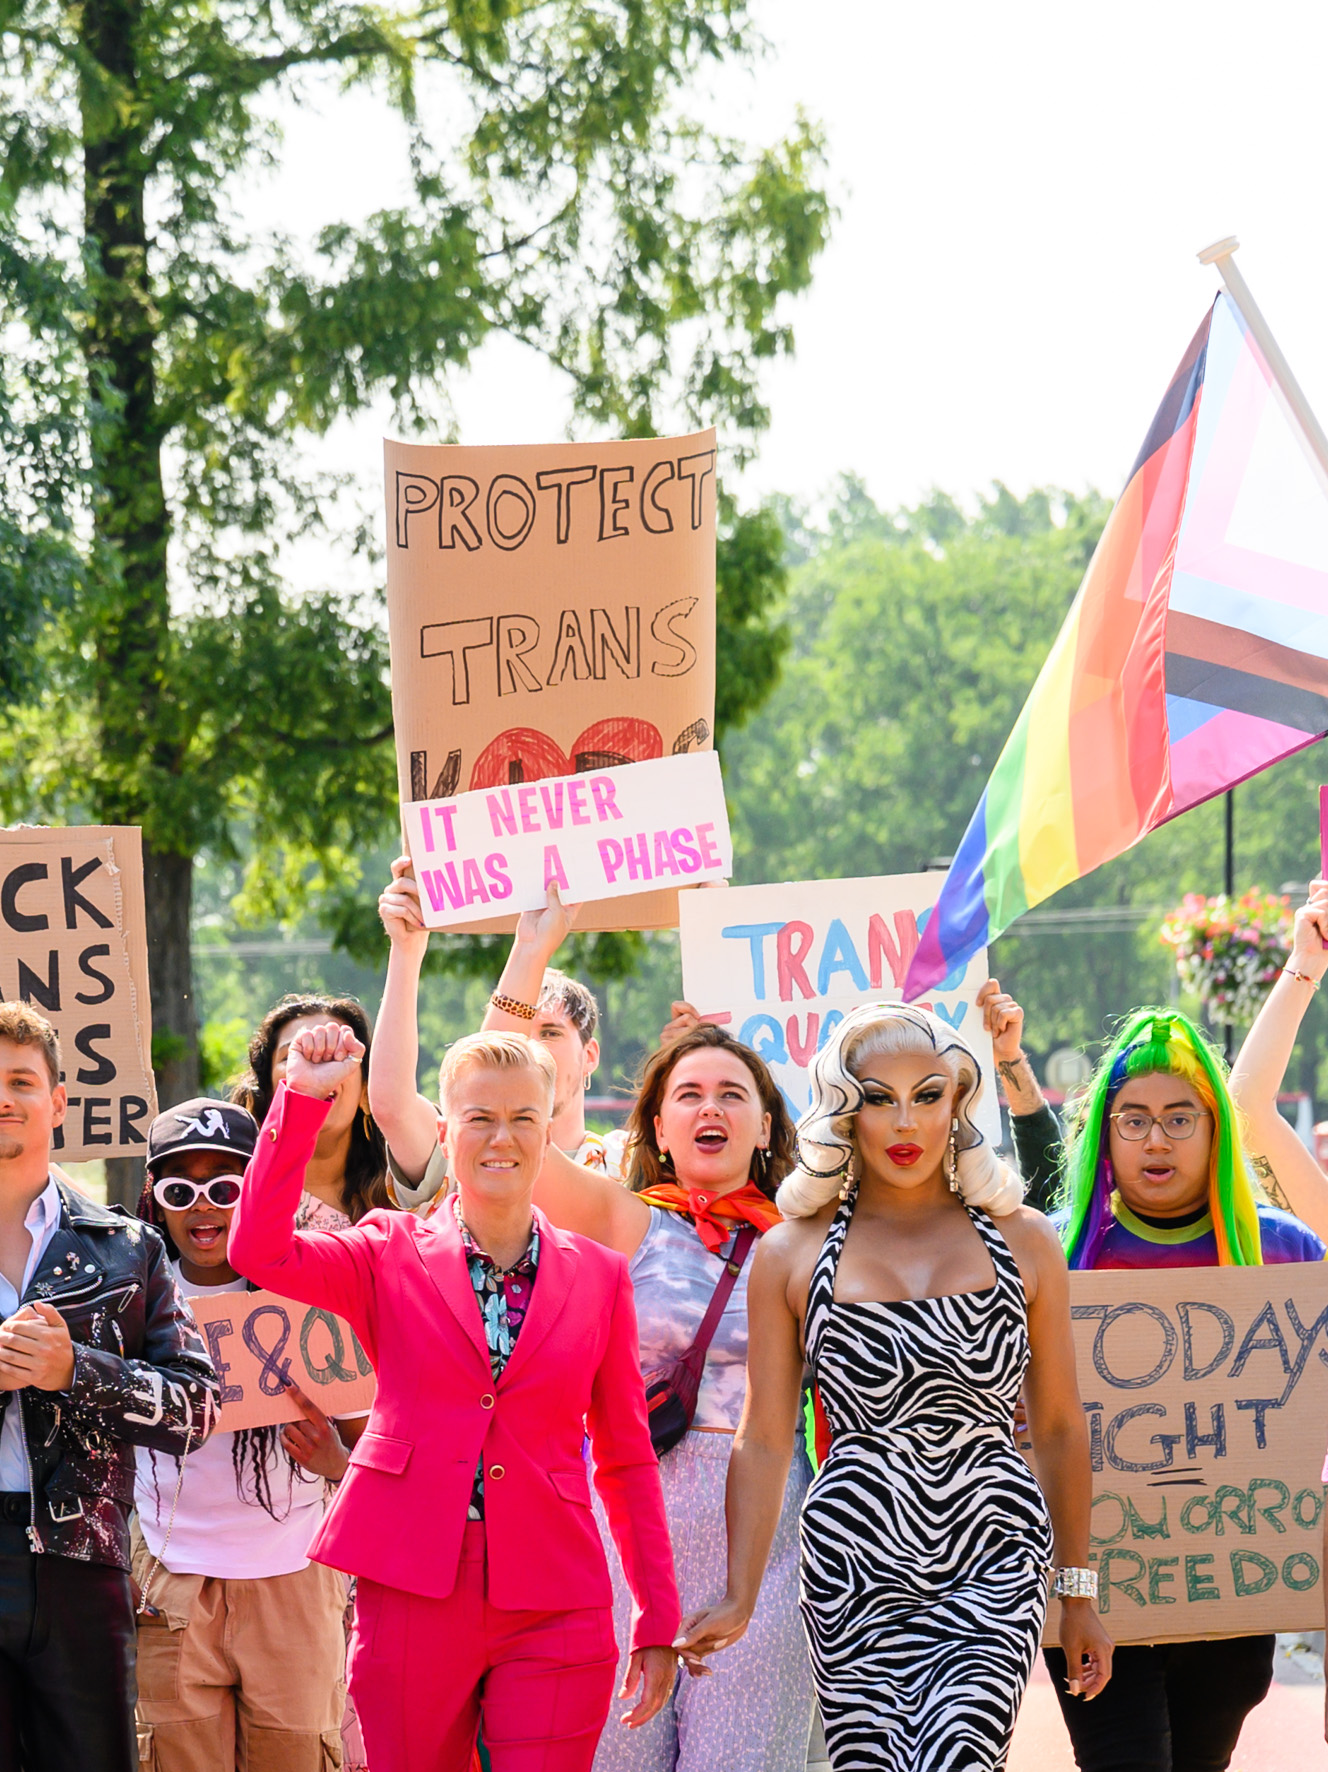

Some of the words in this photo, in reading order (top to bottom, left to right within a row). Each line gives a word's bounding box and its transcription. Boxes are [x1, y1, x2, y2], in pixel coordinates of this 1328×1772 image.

[396, 449, 716, 551] PROTECT
[421, 596, 699, 705] TRANS
[420, 805, 457, 853] IT
[486, 776, 623, 838] NEVER
[421, 853, 514, 913] WAS
[544, 844, 570, 891] A
[597, 822, 723, 884] PHASE
[1083, 1399, 1281, 1473] IGHT
[1089, 1478, 1328, 1547] OMORRO
[1087, 1548, 1320, 1614] REEDO
